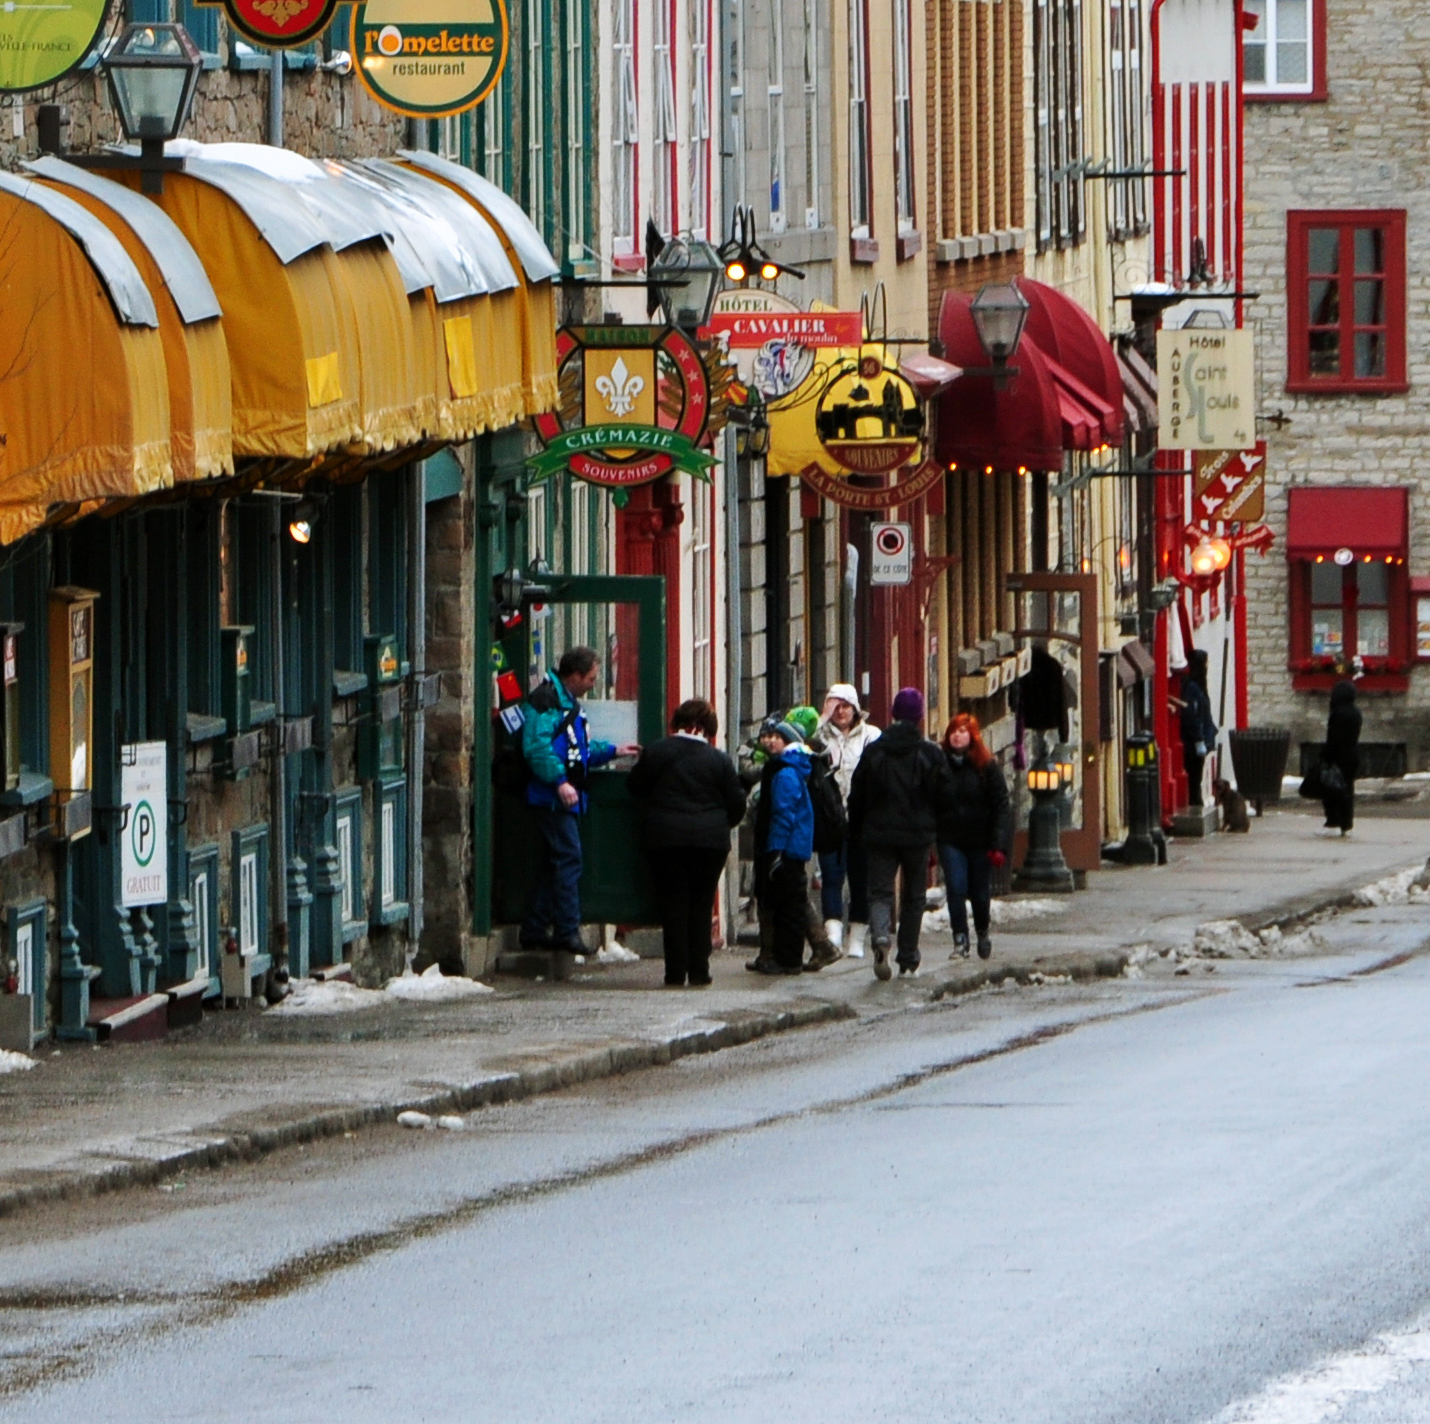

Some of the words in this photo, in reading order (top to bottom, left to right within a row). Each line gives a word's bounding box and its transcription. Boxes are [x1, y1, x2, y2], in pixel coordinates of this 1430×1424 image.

[392, 62, 466, 76] restaurant
[720, 294, 773, 312] HÔTEL
[733, 319, 826, 334] CAVALIER
[1190, 336, 1225, 348] Hôtel
[1171, 348, 1181, 440] AUBERGE
[565, 427, 672, 448] CRÉMAZIE
[582, 462, 658, 481] SOUVENIRS
[827, 480, 870, 505] PORTE
[126, 874, 162, 895] GRATUIT
